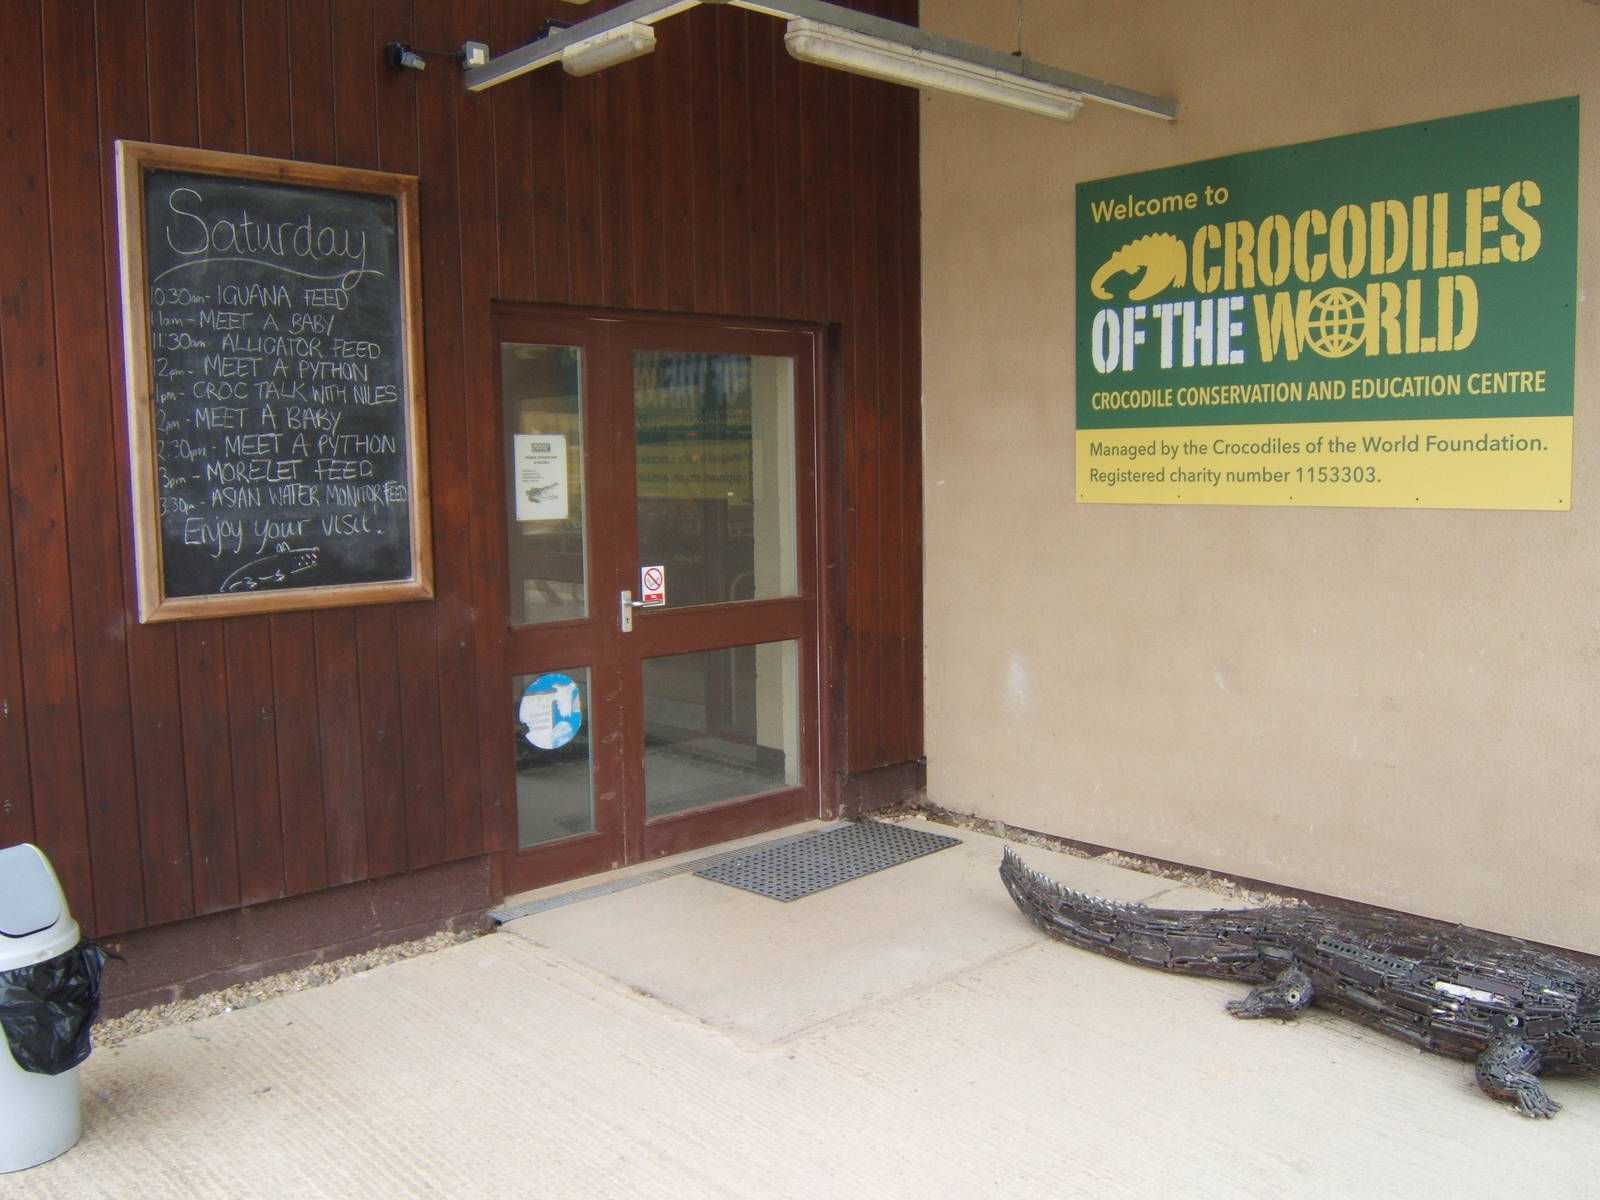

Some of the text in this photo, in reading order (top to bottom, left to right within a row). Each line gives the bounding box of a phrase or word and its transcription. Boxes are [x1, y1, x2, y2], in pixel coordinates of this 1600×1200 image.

[1090, 185, 1229, 224] Welcome to
[166, 188, 366, 290] Saturday
[1192, 180, 1542, 294] CROCODILES
[217, 284, 292, 308] IGUANA
[304, 287, 348, 310] FEED
[200, 309, 254, 331] MEET
[262, 313, 280, 331] A
[288, 312, 335, 336] BABY
[1091, 274, 1479, 374] OF THE WORLD
[222, 333, 324, 358] ALLIGATOR
[329, 338, 381, 359] FEED
[204, 353, 263, 378] MEET
[272, 358, 289, 377] A
[298, 359, 369, 382] PYTHON
[193, 381, 249, 401] CROC
[254, 380, 308, 402] TALK
[312, 384, 348, 405] WITH
[353, 384, 399, 406] NILES
[1091, 369, 1547, 411] CROCODILE CONSERVATION AND EDUCATION CENTRE
[195, 407, 249, 430] MEET
[261, 403, 277, 429] A
[287, 406, 342, 437] BABY
[225, 432, 284, 458] MEET
[292, 432, 311, 457] A
[318, 434, 396, 457] PYTHON
[1089, 434, 1548, 460] Managed by the Crocodiles of the World Foundation.
[207, 459, 304, 485] MORELET
[314, 458, 374, 481] FEED
[1089, 466, 1382, 487] Registered charity number 1153303.
[212, 486, 261, 508] ASIAN
[268, 483, 321, 506] WATER
[184, 516, 243, 558] Enjoy
[254, 519, 311, 555] your
